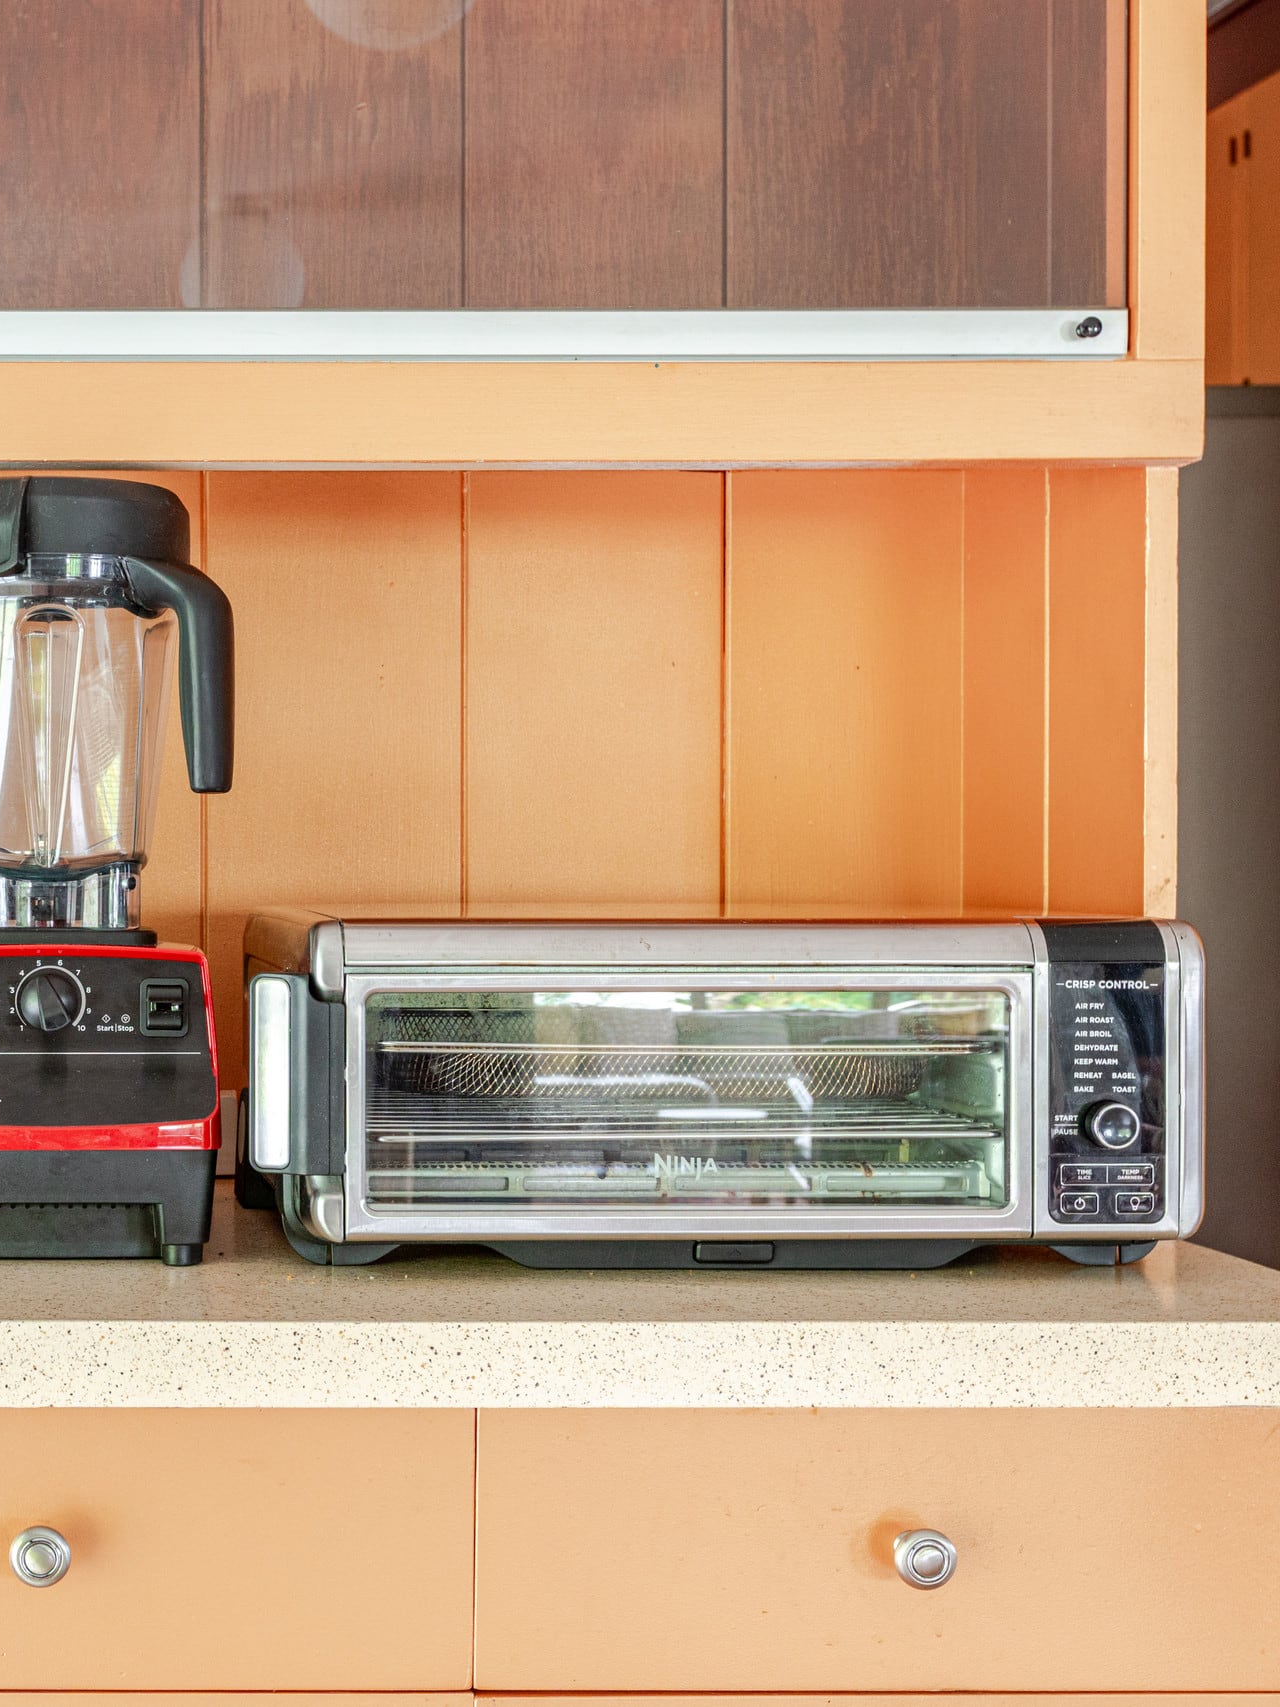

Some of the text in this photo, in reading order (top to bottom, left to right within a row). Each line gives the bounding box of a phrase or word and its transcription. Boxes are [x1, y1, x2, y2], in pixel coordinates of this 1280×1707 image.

[1065, 980, 1150, 990] CRISP CONTROL
[654, 1152, 719, 1181] NINJA
